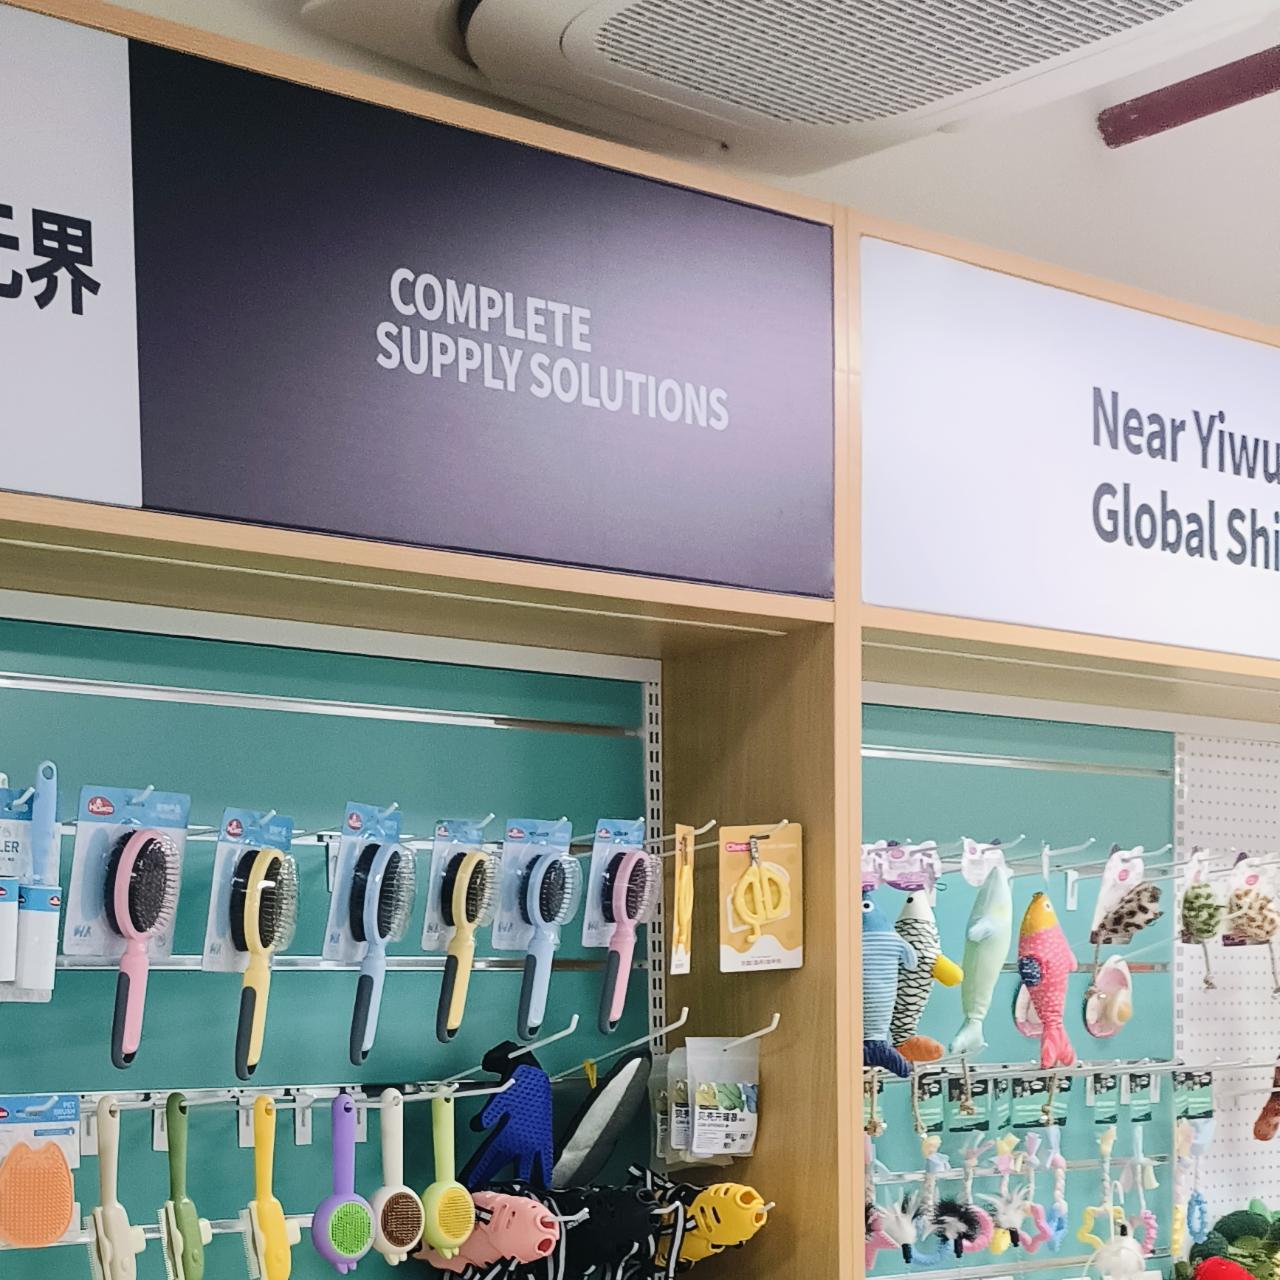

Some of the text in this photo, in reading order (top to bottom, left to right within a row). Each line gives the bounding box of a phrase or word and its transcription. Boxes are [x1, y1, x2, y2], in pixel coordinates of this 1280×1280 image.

[390, 267, 592, 353] COMPLETE
[376, 321, 729, 431] SUPPLY SOLUTIONS
[1093, 386, 1280, 485] Near Yiwu
[1092, 482, 1218, 561] Global
